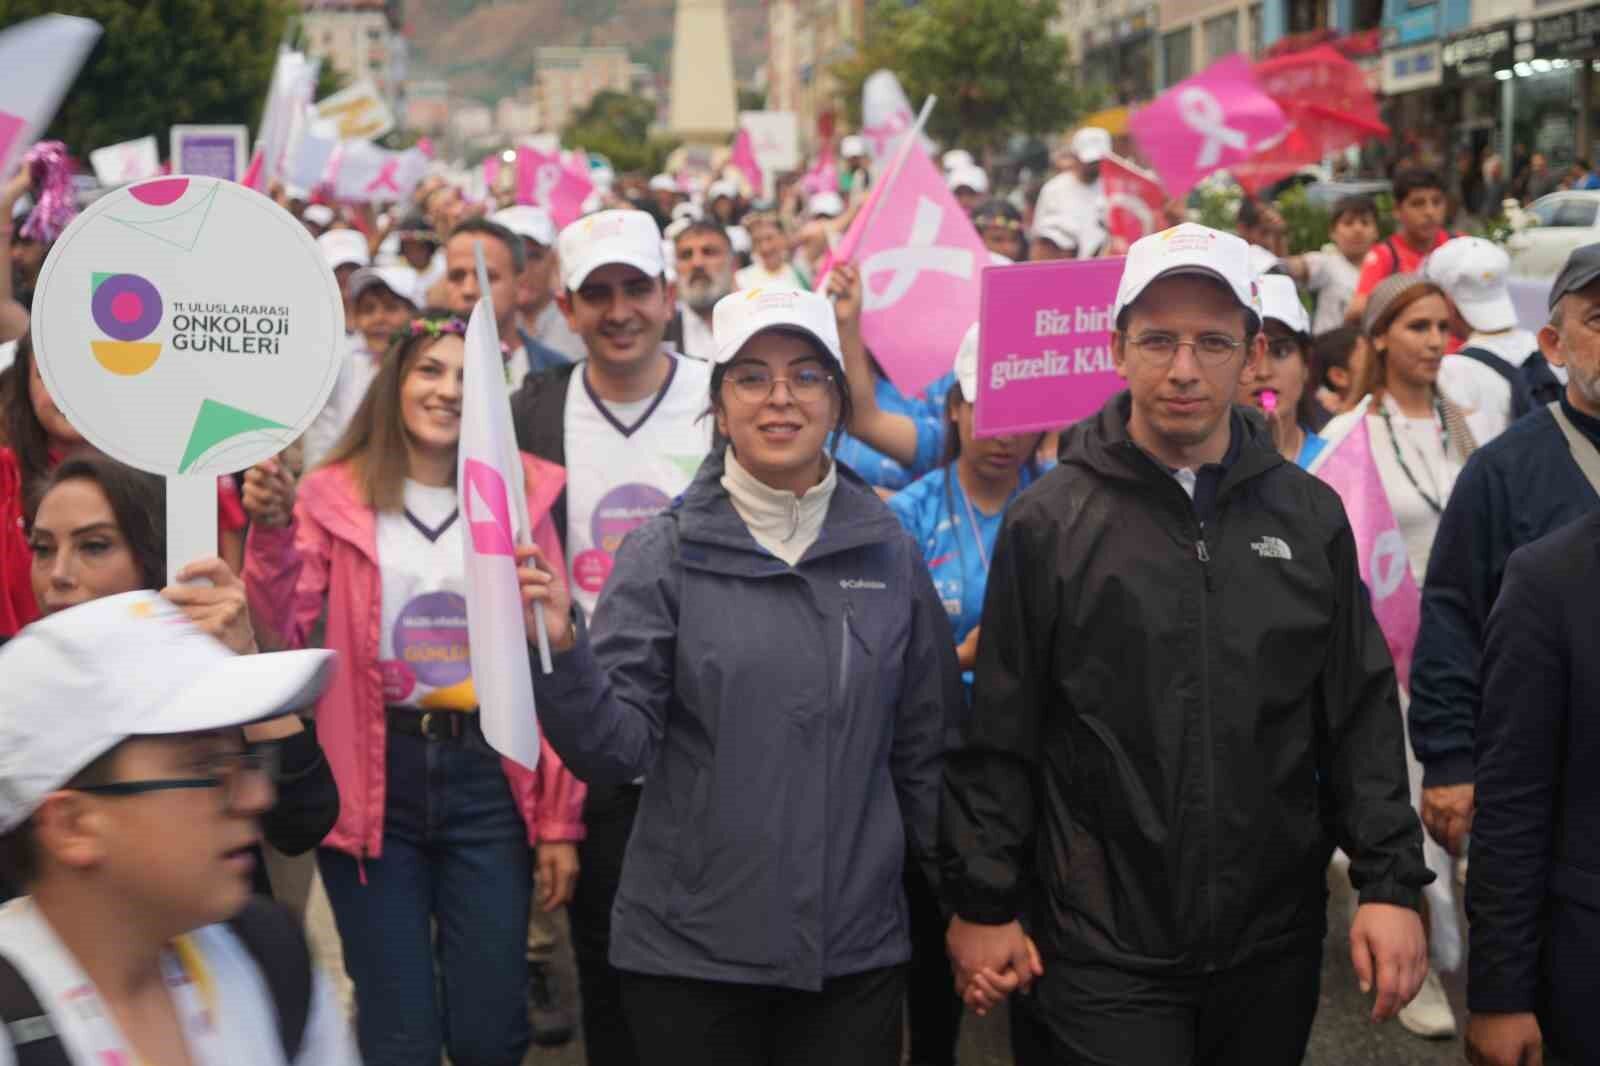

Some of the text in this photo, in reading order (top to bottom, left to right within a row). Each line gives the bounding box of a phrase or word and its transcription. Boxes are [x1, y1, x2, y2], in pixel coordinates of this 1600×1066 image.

[188, 303, 289, 317] ULUSLARARASI
[1035, 309, 1071, 336] Biz
[991, 349, 1070, 389] güzeliz
